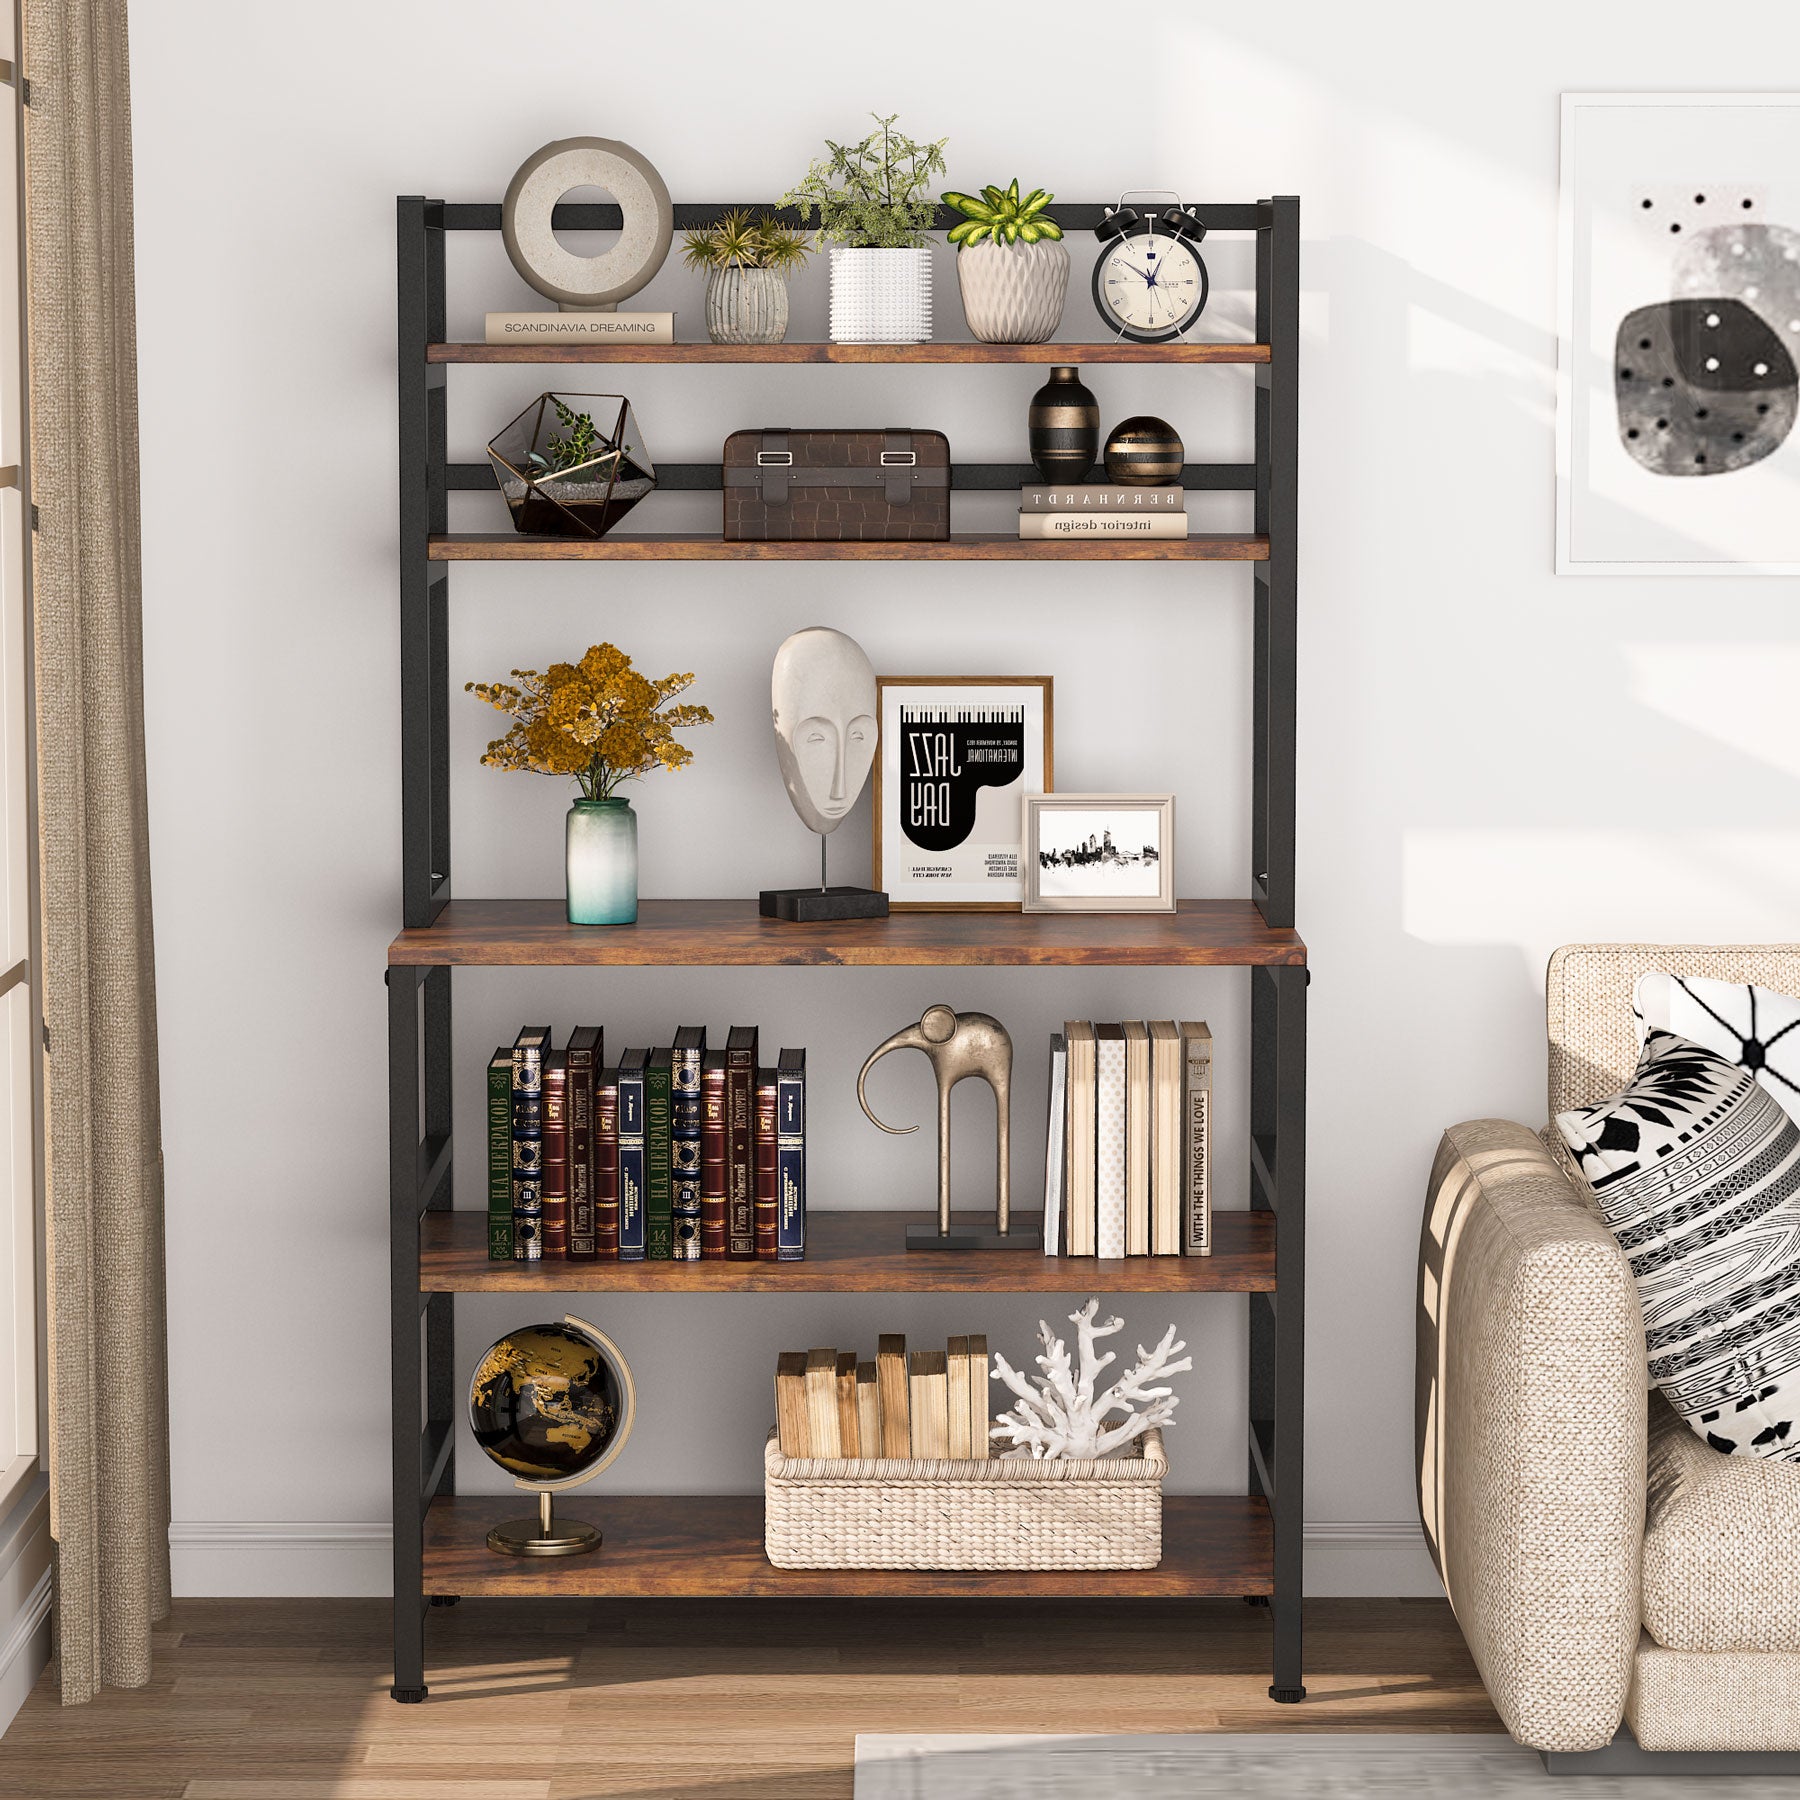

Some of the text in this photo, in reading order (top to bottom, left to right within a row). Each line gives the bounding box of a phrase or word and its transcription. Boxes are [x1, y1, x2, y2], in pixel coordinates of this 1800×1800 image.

[1126, 243, 1135, 252] 11
[1111, 258, 1120, 267] 10
[1181, 297, 1188, 305] 4
[504, 323, 655, 333] SCANDINAVIA DREAMING
[490, 1097, 509, 1171] НЕКРАСОВ
[650, 1097, 669, 1171] НЕКРАСОВ
[1193, 1097, 1205, 1242] WITH THE THINGS WE LOVE
[522, 1191, 532, 1200] III
[682, 1191, 691, 1200] III
[494, 1230, 508, 1242] 14
[653, 1230, 667, 1242] 14
